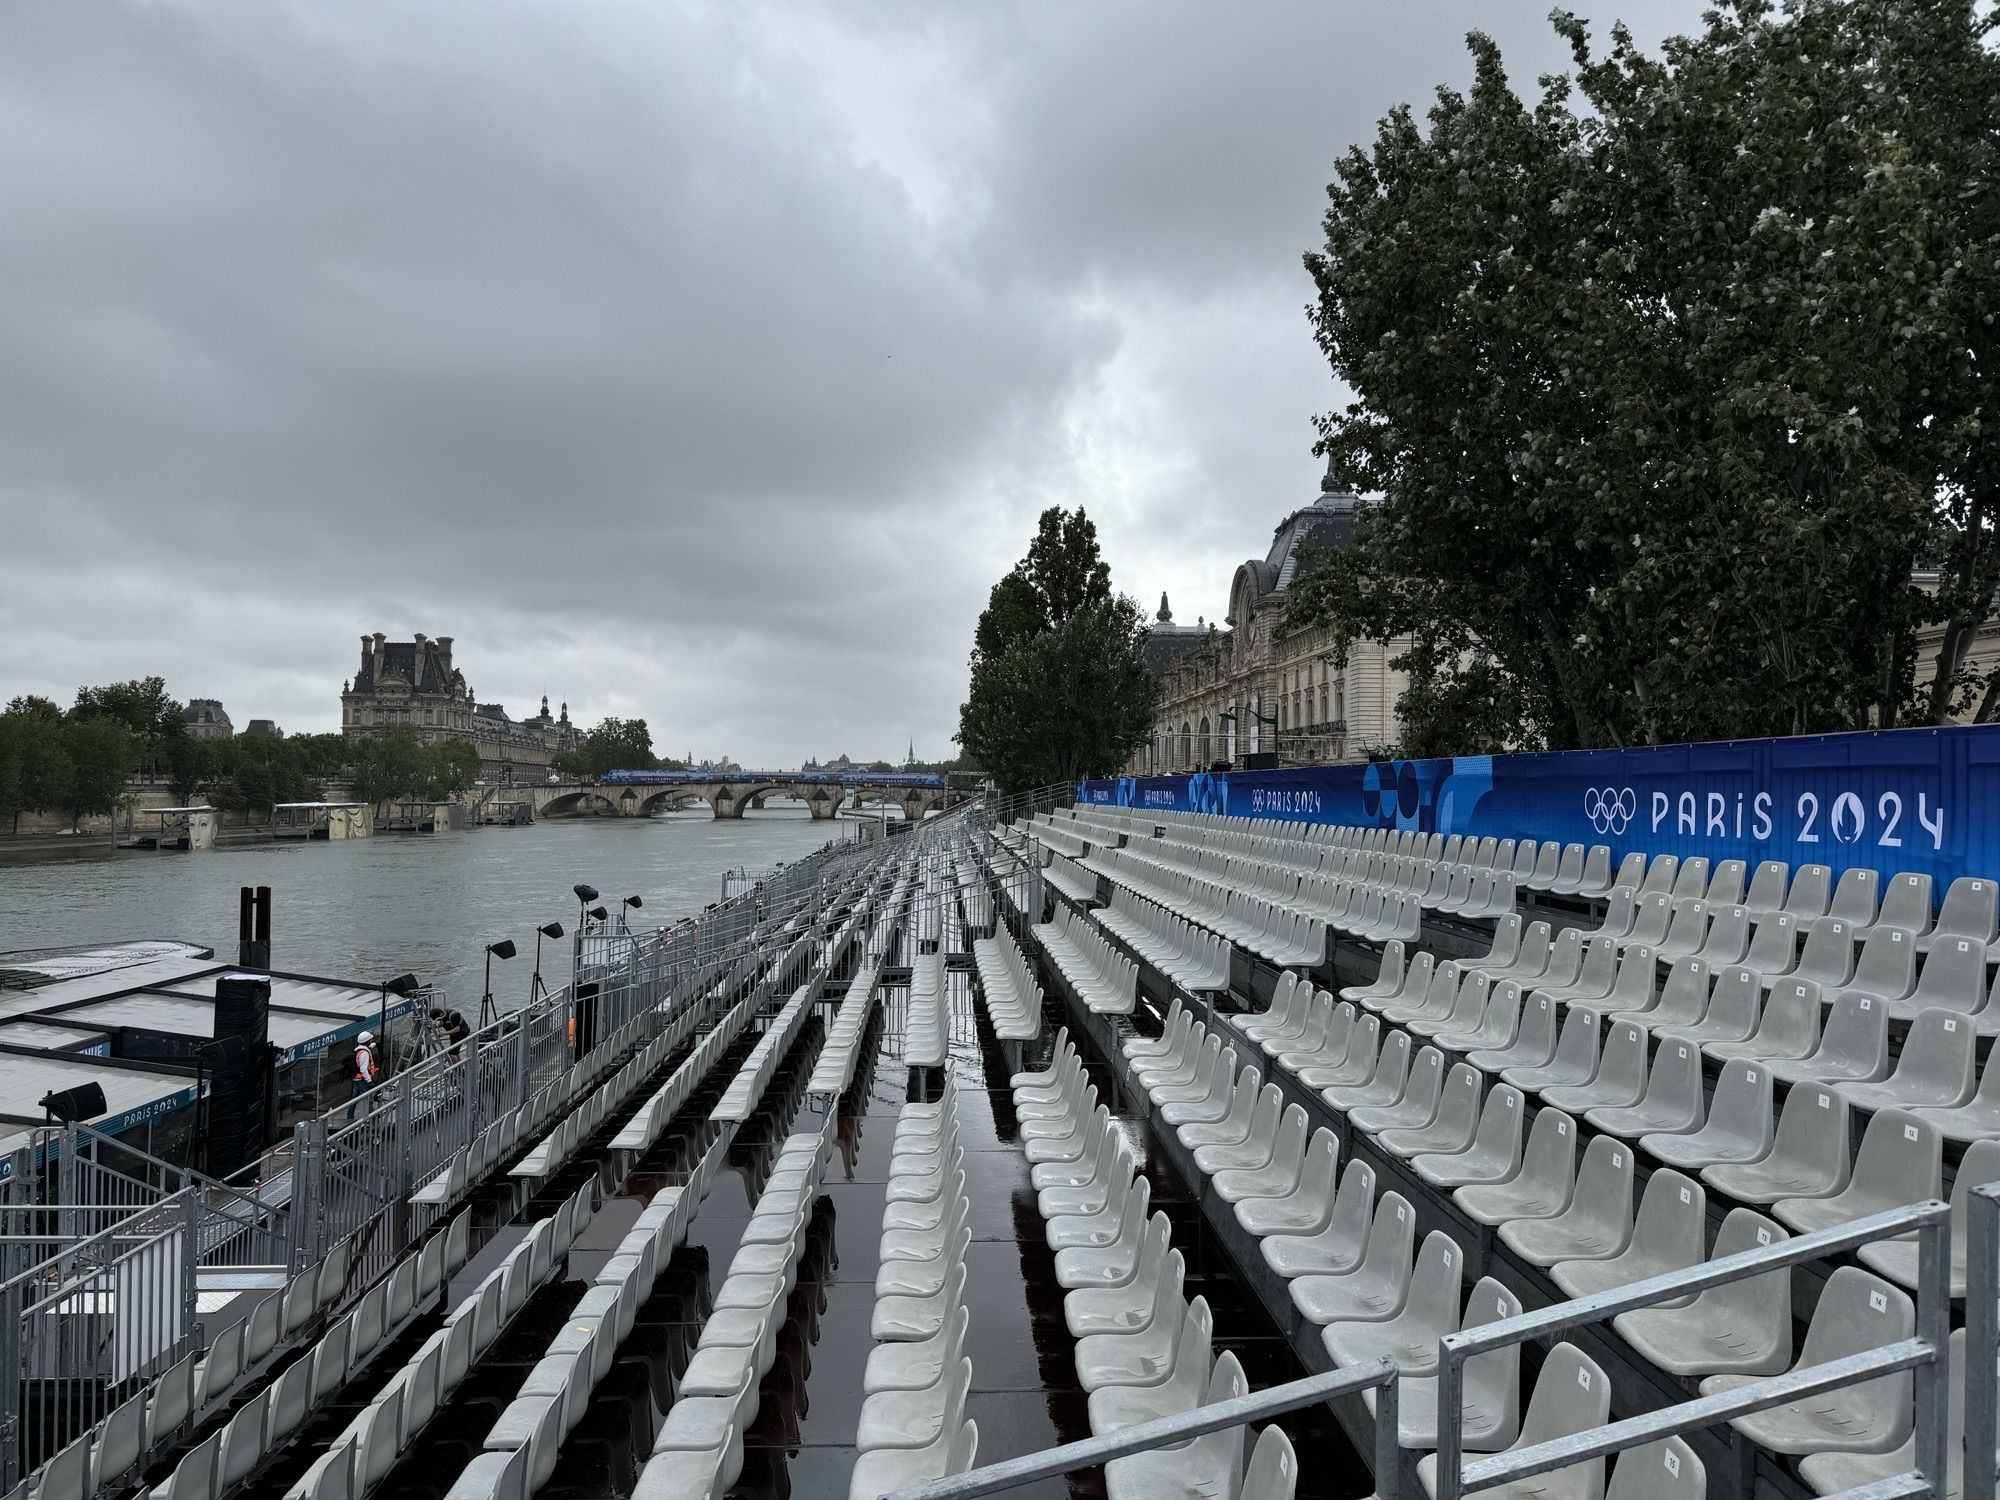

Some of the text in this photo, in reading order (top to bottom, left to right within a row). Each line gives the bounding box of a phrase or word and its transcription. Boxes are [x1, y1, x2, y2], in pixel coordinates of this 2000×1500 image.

[1294, 790, 1320, 813] 2024
[1797, 791, 1944, 850] 2024
[153, 1097, 178, 1115] 2024
